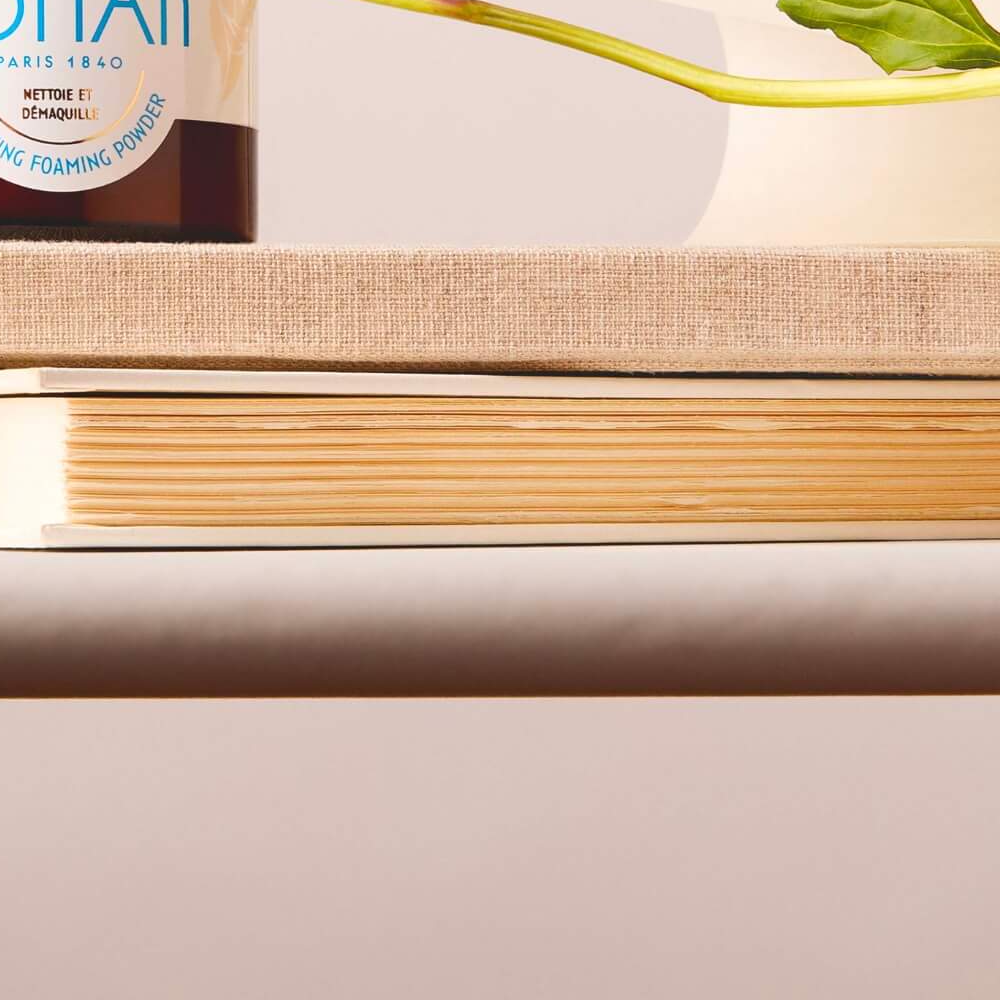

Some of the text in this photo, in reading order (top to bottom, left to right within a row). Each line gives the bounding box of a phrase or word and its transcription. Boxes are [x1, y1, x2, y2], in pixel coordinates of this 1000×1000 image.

[66, 55, 124, 70] 1840
[23, 87, 93, 101] NETTOIE ET
[21, 104, 99, 121] DÉMAQUILLE
[30, 149, 112, 176] FOAMING
[113, 93, 166, 157] POWDER
